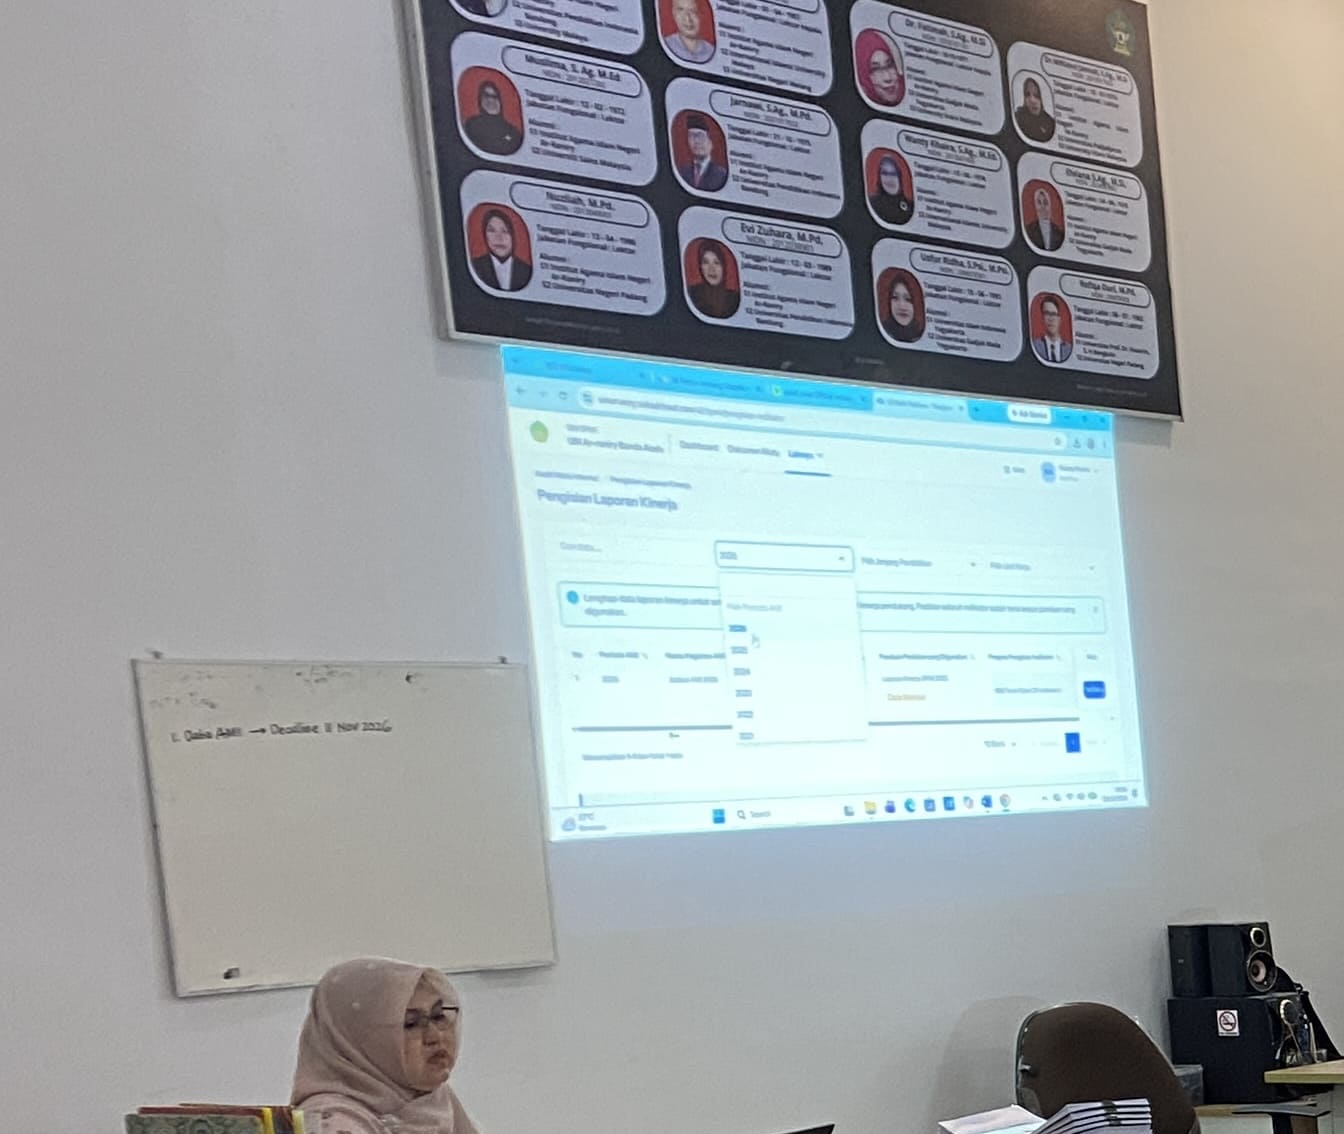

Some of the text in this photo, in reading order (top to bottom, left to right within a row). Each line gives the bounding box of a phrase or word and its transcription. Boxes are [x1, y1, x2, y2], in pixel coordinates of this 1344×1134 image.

[740, 222, 755, 234] Evi
[537, 488, 678, 512] Pengisian Laporan Kinerja
